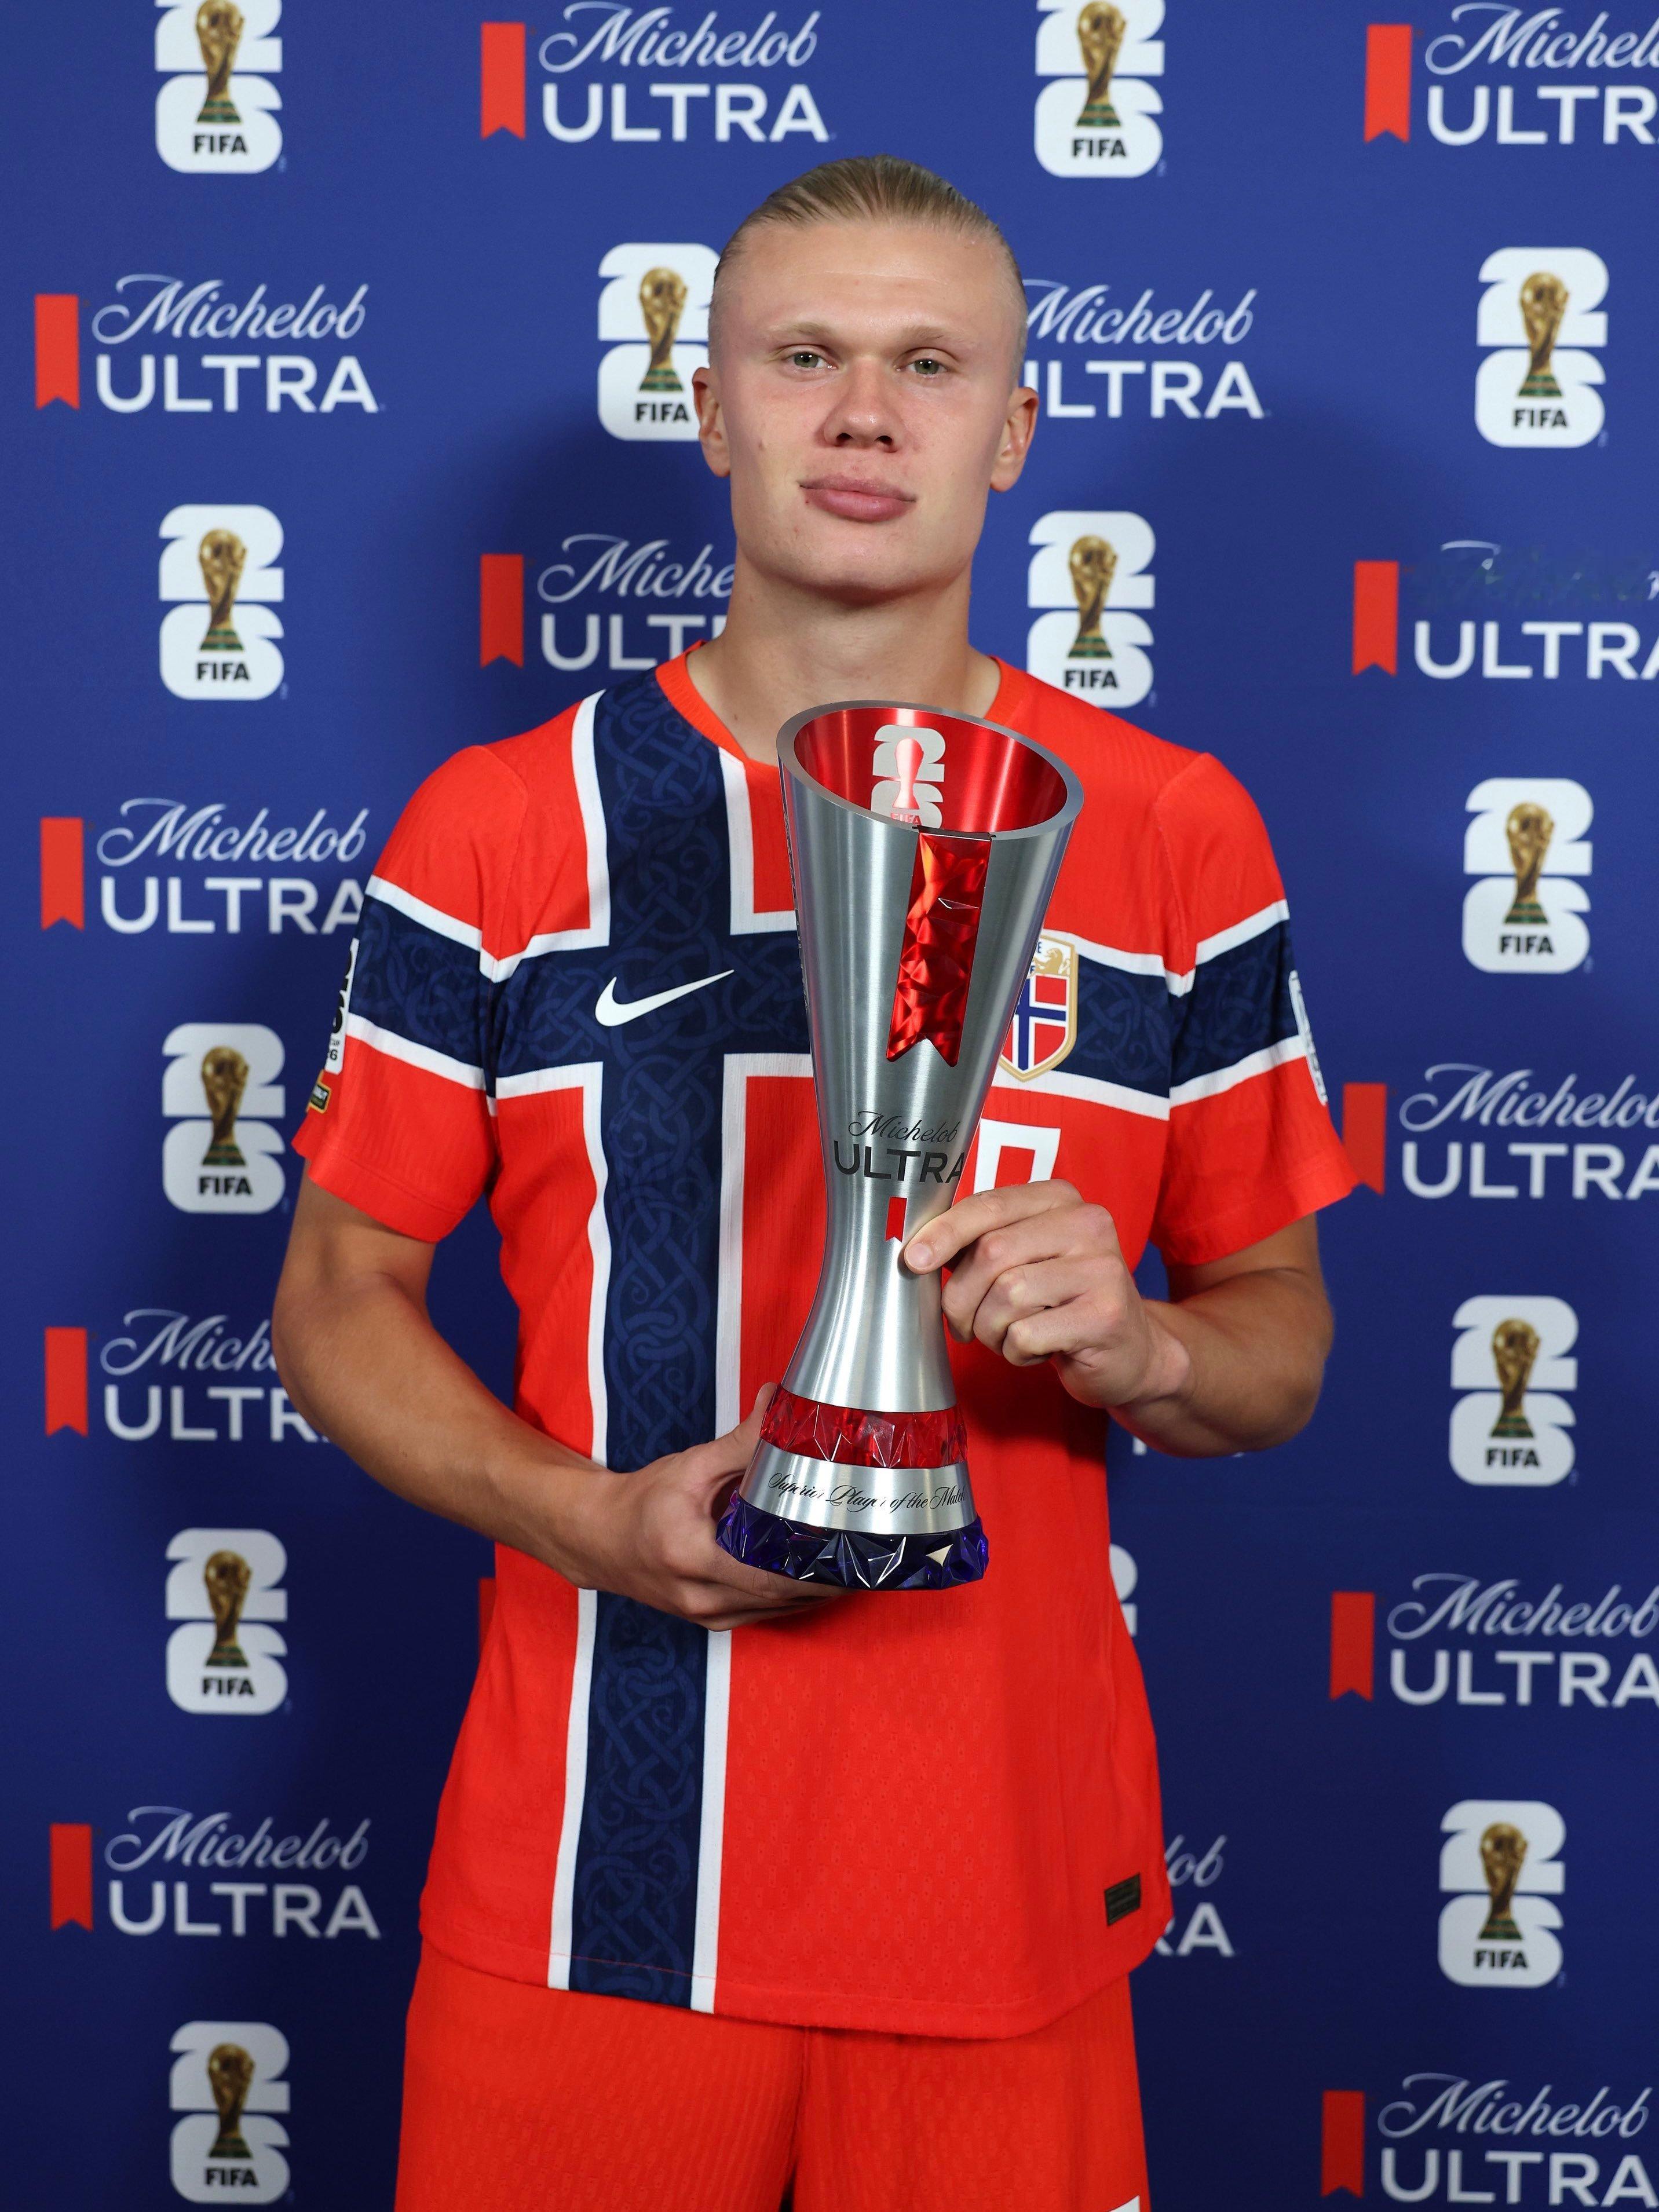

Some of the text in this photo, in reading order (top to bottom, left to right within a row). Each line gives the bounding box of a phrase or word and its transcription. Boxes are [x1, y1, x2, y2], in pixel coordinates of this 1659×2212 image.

[539, 2, 820, 72] Michelob
[1426, 2, 1659, 75] Michel
[543, 83, 829, 142] ULTRA
[1428, 85, 1659, 146] ULTR
[193, 134, 247, 153] FIFA
[1073, 139, 1126, 157] FIFA
[93, 275, 368, 344] Michelob
[1021, 279, 1256, 345] Michelob
[96, 354, 378, 413] ULTRA
[635, 403, 689, 422] FIFA
[1024, 360, 1264, 419] LTRA
[1514, 409, 1567, 427] FIFA
[538, 533, 735, 603] Miche
[197, 662, 249, 680] FIFA
[542, 613, 727, 671] ULT
[1065, 670, 1118, 688] FIFA
[97, 799, 368, 866] Michelob
[101, 876, 365, 934] ULTRA
[1500, 935, 1553, 954] FIFA
[849, 1111, 960, 1142] Michelob
[199, 1176, 252, 1195] FIFA
[100, 1309, 277, 1376] Mich
[104, 1384, 330, 1442] ULTR
[1486, 1449, 1540, 1467] FIFA
[889, 1491, 916, 1514] of
[906, 1492, 928, 1509] the
[1388, 1574, 1659, 1639] Michelob
[203, 1677, 254, 1696] FIFA
[1391, 1650, 1659, 1707] ULTRA
[106, 1807, 368, 1871] Michelob
[109, 1880, 379, 1937] ULTRA
[1474, 1950, 1528, 1969] FIFA
[1378, 2074, 1652, 2137] Michelob
[205, 2168, 258, 2187] FIFA
[1382, 2148, 1659, 2208] ULTRA
